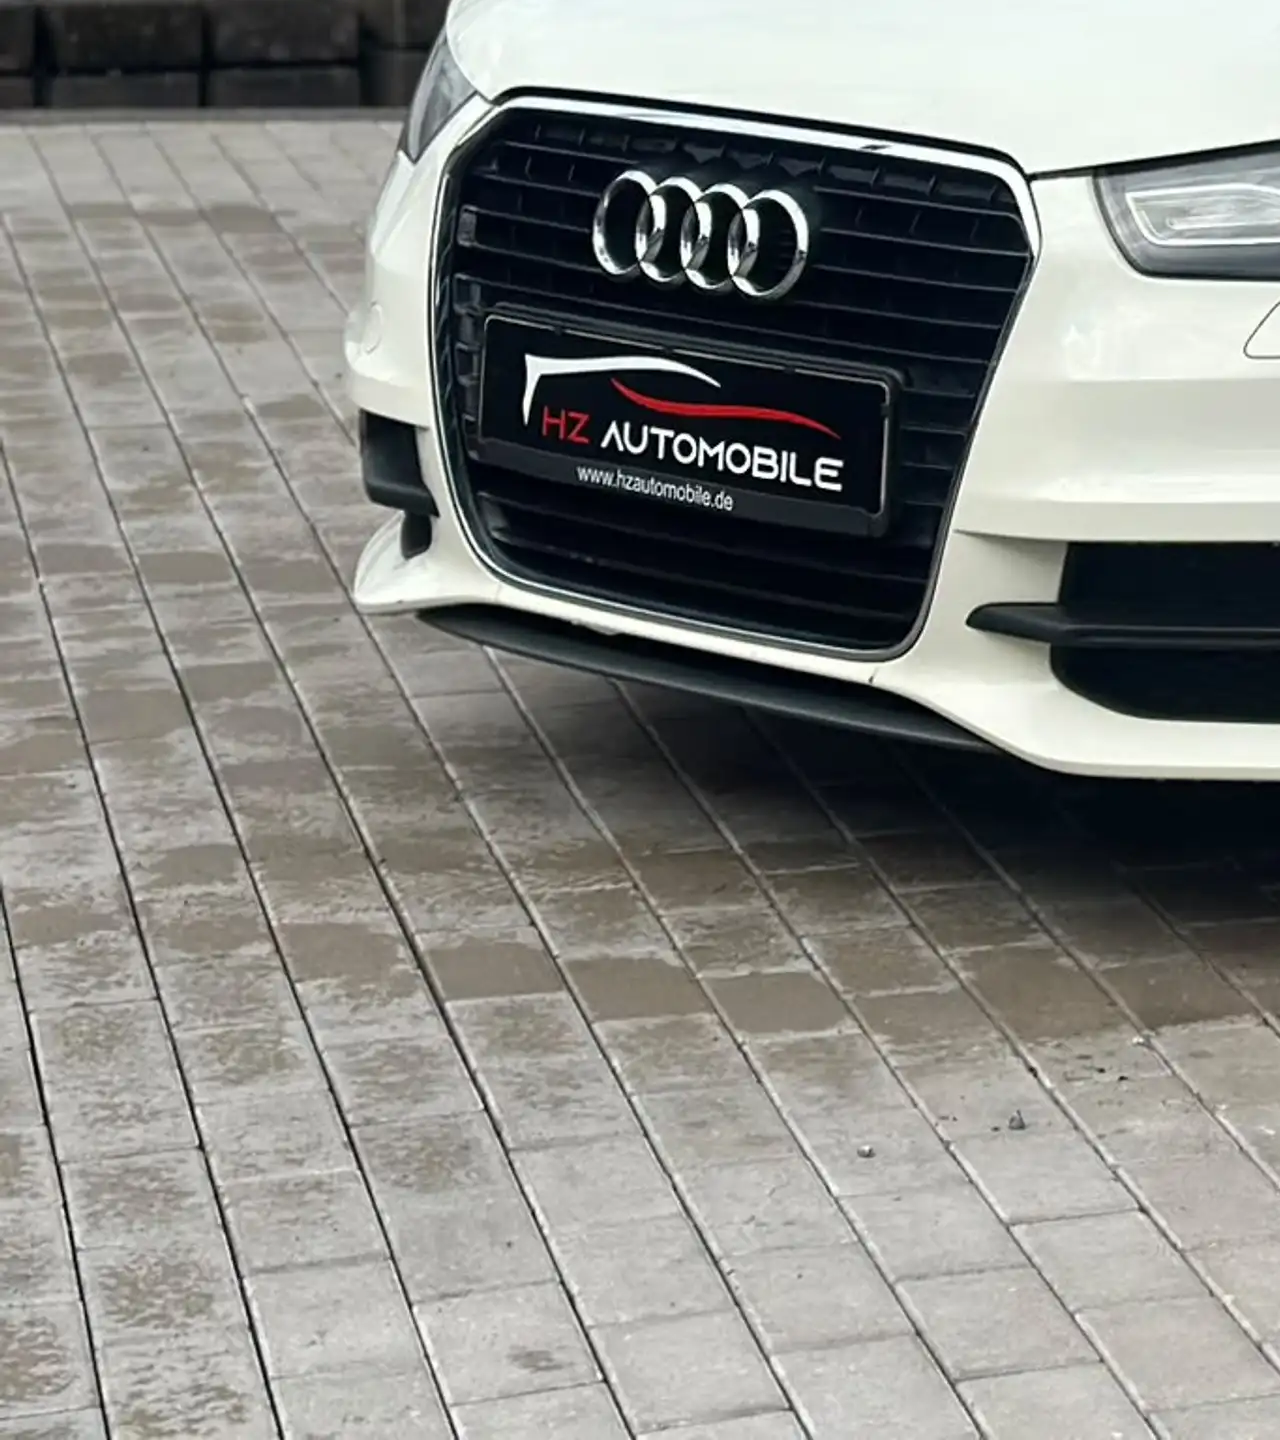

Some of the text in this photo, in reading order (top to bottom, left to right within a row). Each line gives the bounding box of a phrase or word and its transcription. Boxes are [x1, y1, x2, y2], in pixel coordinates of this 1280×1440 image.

[540, 405, 844, 491] HZ AUTOMOBILE
[576, 464, 734, 511] www.hzautomobile.de
